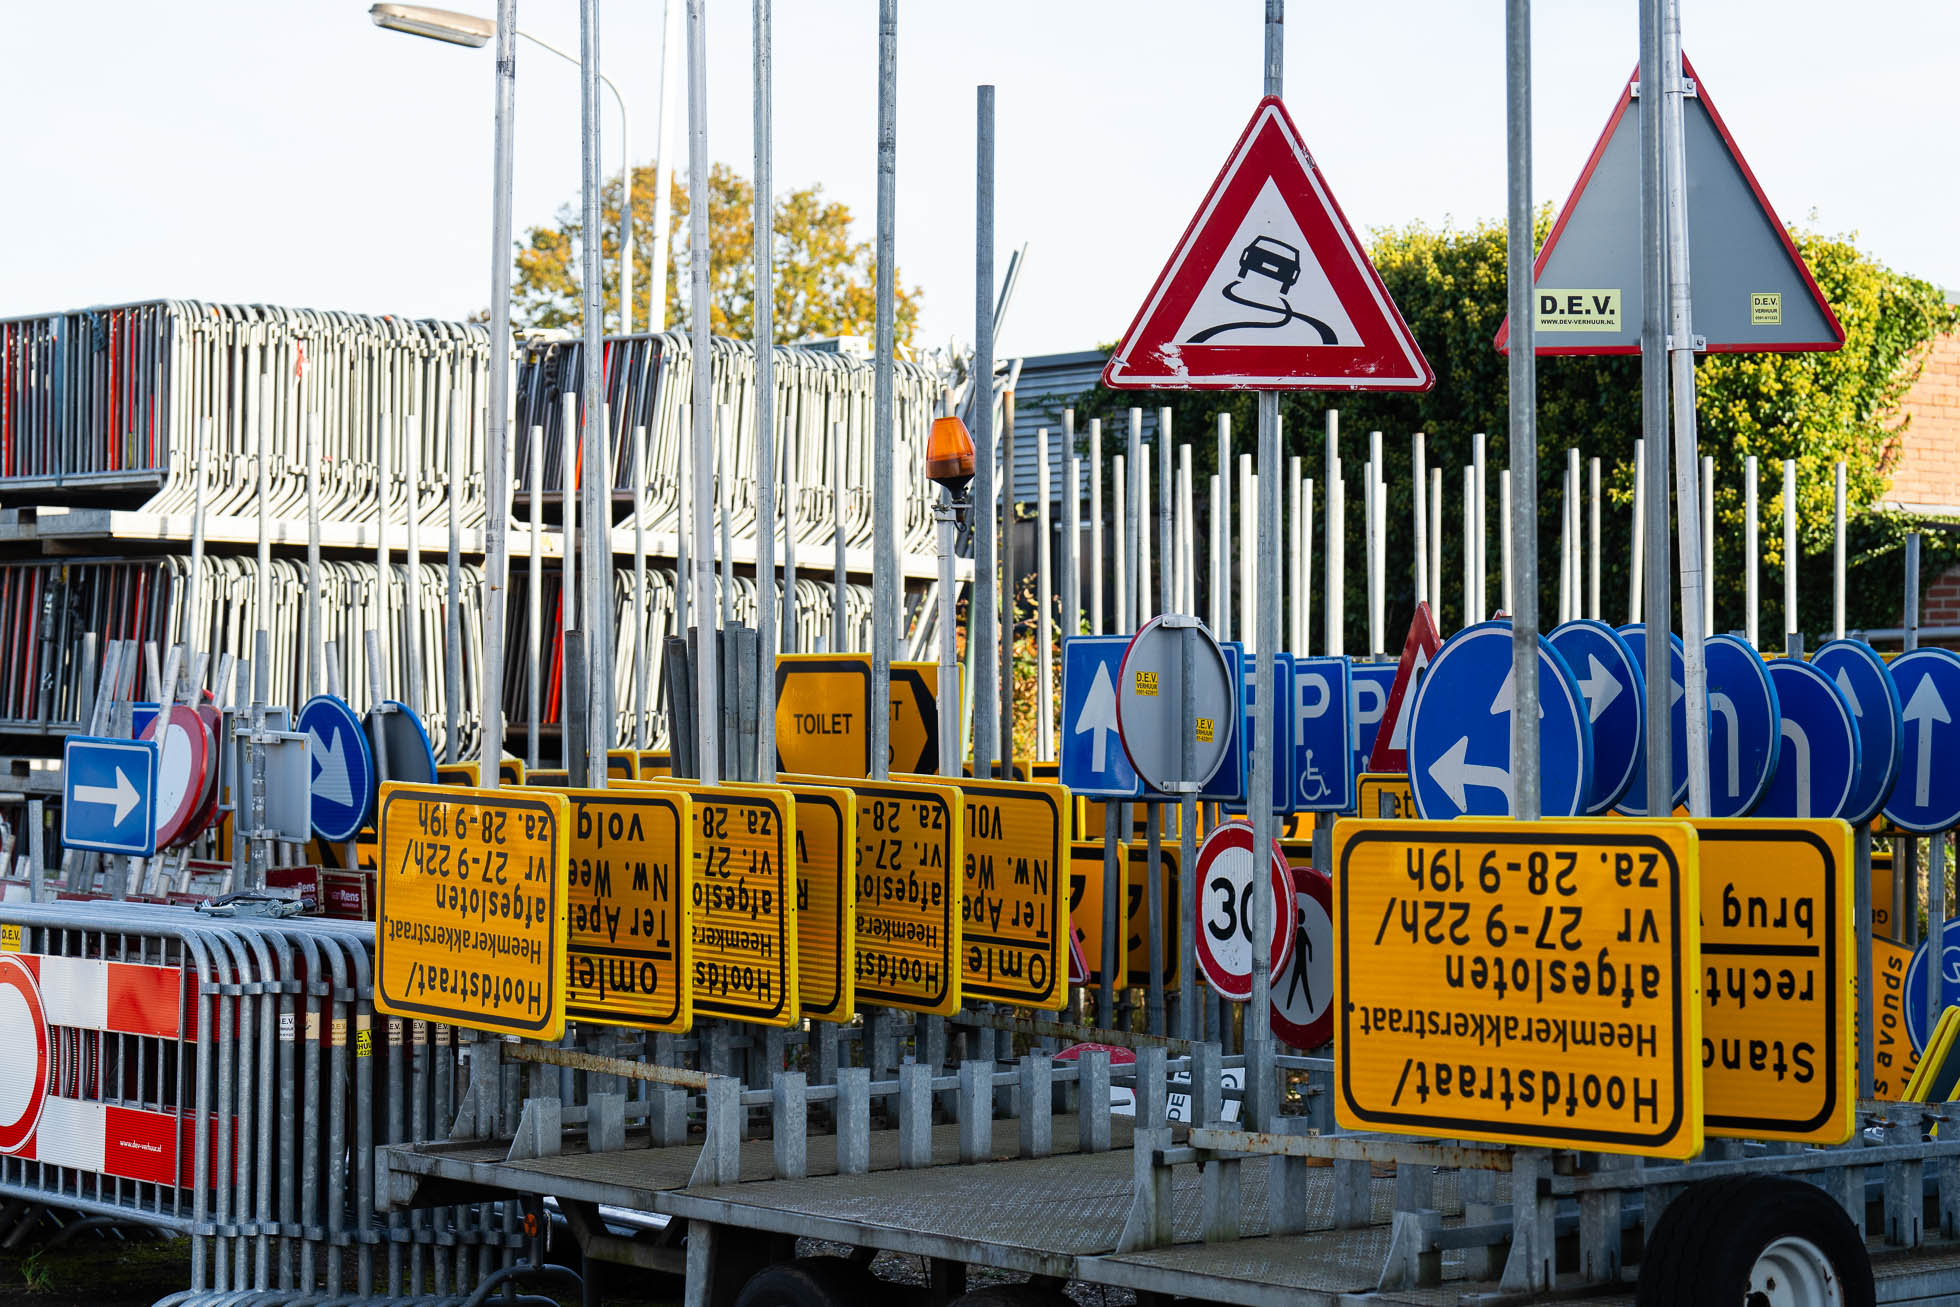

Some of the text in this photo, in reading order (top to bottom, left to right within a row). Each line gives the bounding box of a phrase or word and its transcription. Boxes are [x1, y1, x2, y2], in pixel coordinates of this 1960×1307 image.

[1540, 296, 1615, 315] D.E.V.
[1136, 673, 1158, 683] D.E.V.
[794, 713, 853, 735] TOILET
[1196, 719, 1213, 730] .E.V.
[419, 803, 549, 844] za. 28-9 19h
[577, 802, 644, 849] volg
[693, 807, 771, 839] za. 28-
[856, 801, 942, 832] za. 28-
[964, 804, 1002, 840] VOL
[401, 838, 546, 885] vr 27-9 22h/
[693, 846, 772, 878] vr. 27-
[913, 843, 941, 867] vr.
[966, 853, 1047, 895] Nw. We
[1407, 847, 1659, 896] za. 28-9 19h
[569, 858, 668, 901] Nw. Wee
[693, 877, 772, 920] afgeslo
[855, 870, 941, 911] afgeslot
[436, 884, 545, 929] afgesloten
[630, 908, 670, 947] Ter
[962, 889, 1003, 933] Ape
[1012, 901, 1048, 938] Ter
[1374, 896, 1660, 951] vr 27-9 22h/
[1722, 882, 1813, 938] brug
[2, 929, 20, 941] D.E.V.
[856, 915, 937, 948] Heemkera
[404, 962, 541, 1015] Hoofdstraat/
[569, 956, 657, 1001] omlei
[693, 961, 771, 1002] Hoofds
[855, 951, 938, 993] Hoofdst
[968, 946, 1046, 989] Omle
[1446, 947, 1660, 1008] afgesloten
[1705, 966, 1813, 1009] recht
[1875, 956, 1902, 1068] avonds
[1391, 1058, 1658, 1124] Hoofdstraat/
